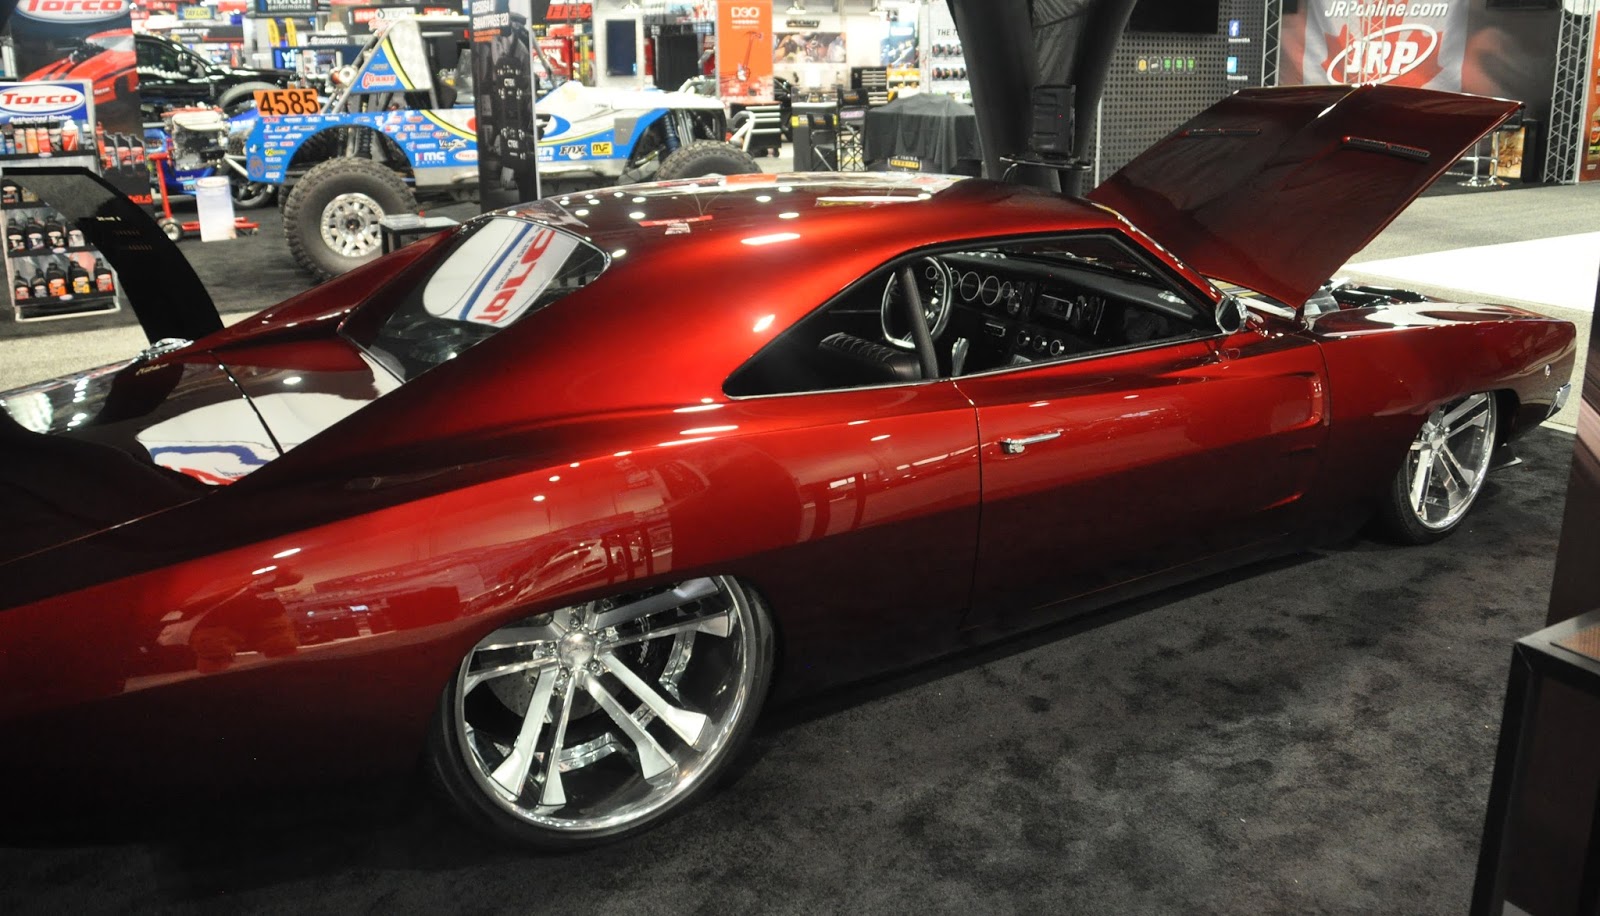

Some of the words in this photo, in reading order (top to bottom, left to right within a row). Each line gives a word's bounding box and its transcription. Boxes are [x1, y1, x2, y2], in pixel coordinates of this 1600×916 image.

[28, 0, 122, 11] Torco
[1325, 0, 1448, 17] JRPonline.com
[185, 9, 209, 18] TAYLOR
[1346, 40, 1419, 75] JRP
[3, 93, 78, 105] Torco
[260, 91, 319, 116] 4585
[9, 115, 47, 123] Authorized
[560, 145, 586, 156] FOX
